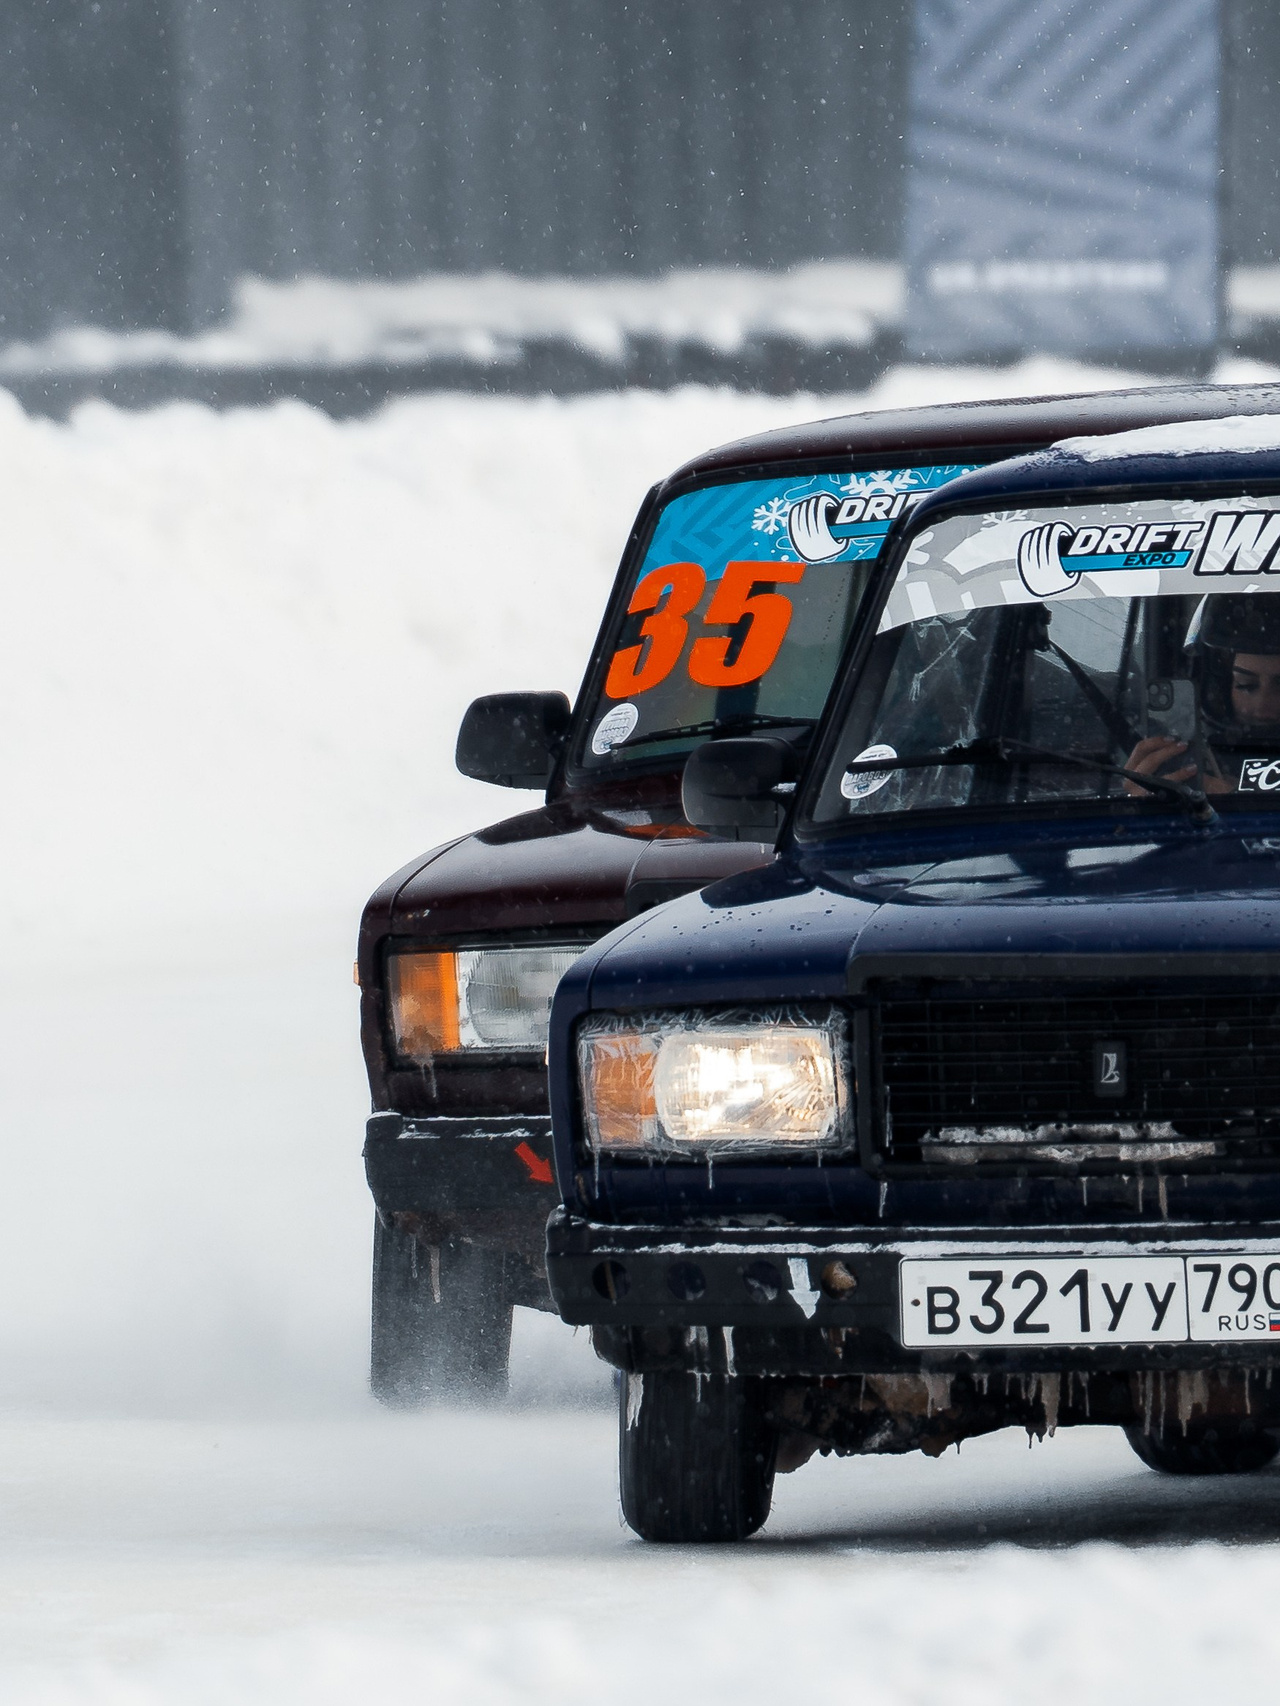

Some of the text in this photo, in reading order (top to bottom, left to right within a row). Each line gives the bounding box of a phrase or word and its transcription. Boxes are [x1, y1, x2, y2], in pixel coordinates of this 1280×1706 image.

[1068, 523, 1202, 556] DRIFT
[1122, 552, 1177, 567] EXPO
[605, 561, 807, 699] 35
[1218, 1314, 1267, 1332] RUS
